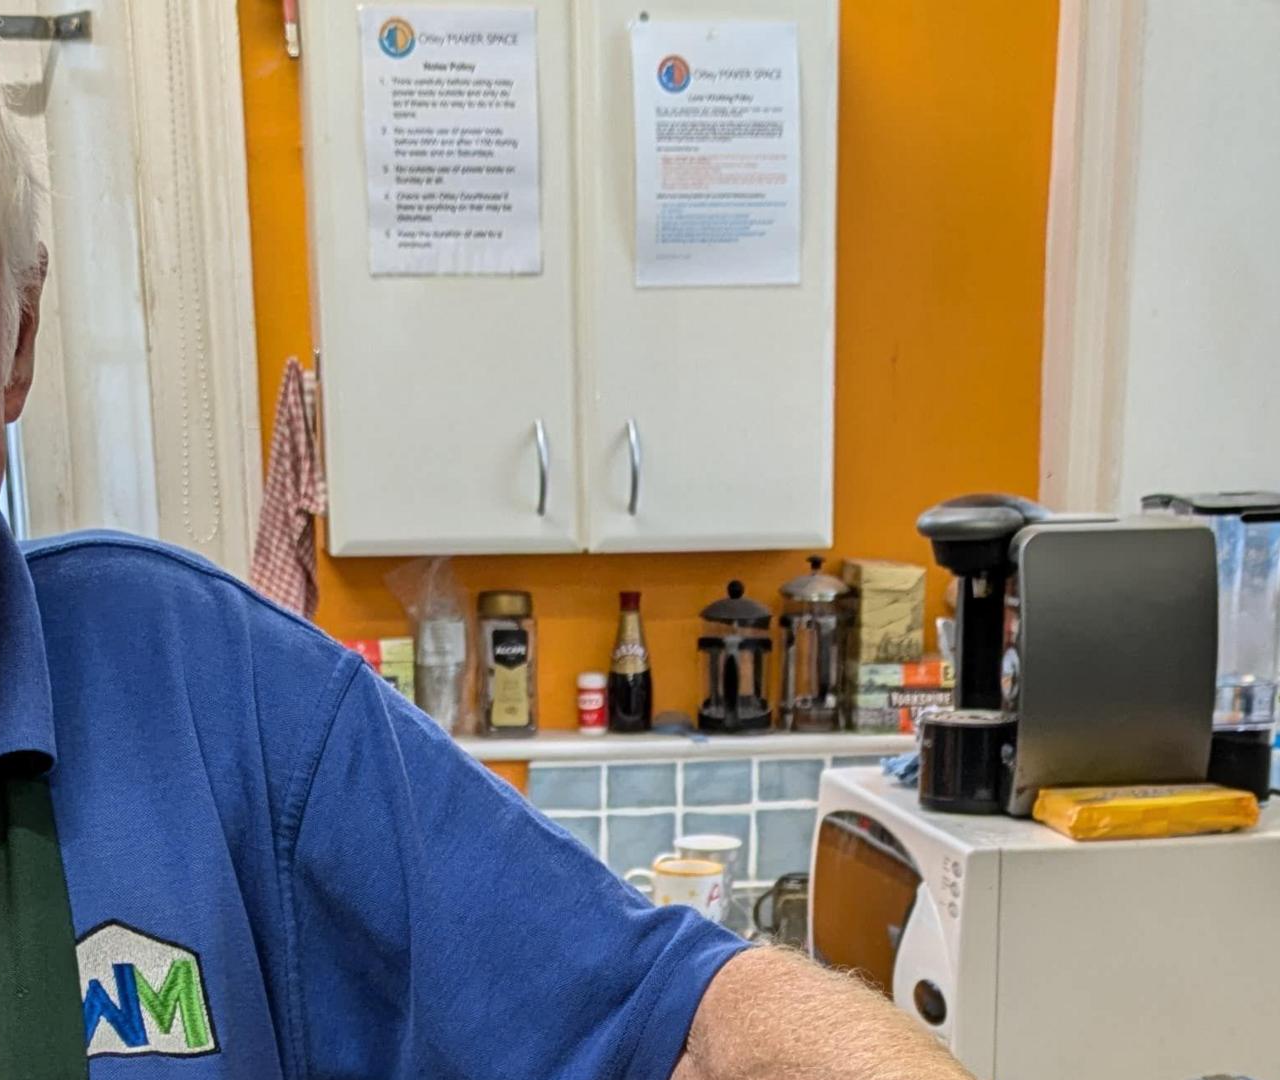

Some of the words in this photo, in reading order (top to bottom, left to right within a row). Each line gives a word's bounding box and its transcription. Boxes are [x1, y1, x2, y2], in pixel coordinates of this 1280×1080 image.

[419, 32, 445, 47] Otley
[448, 33, 483, 45] MAKER
[487, 33, 519, 46] SPACE
[719, 69, 751, 80] MAKER
[754, 68, 782, 80] SPACE
